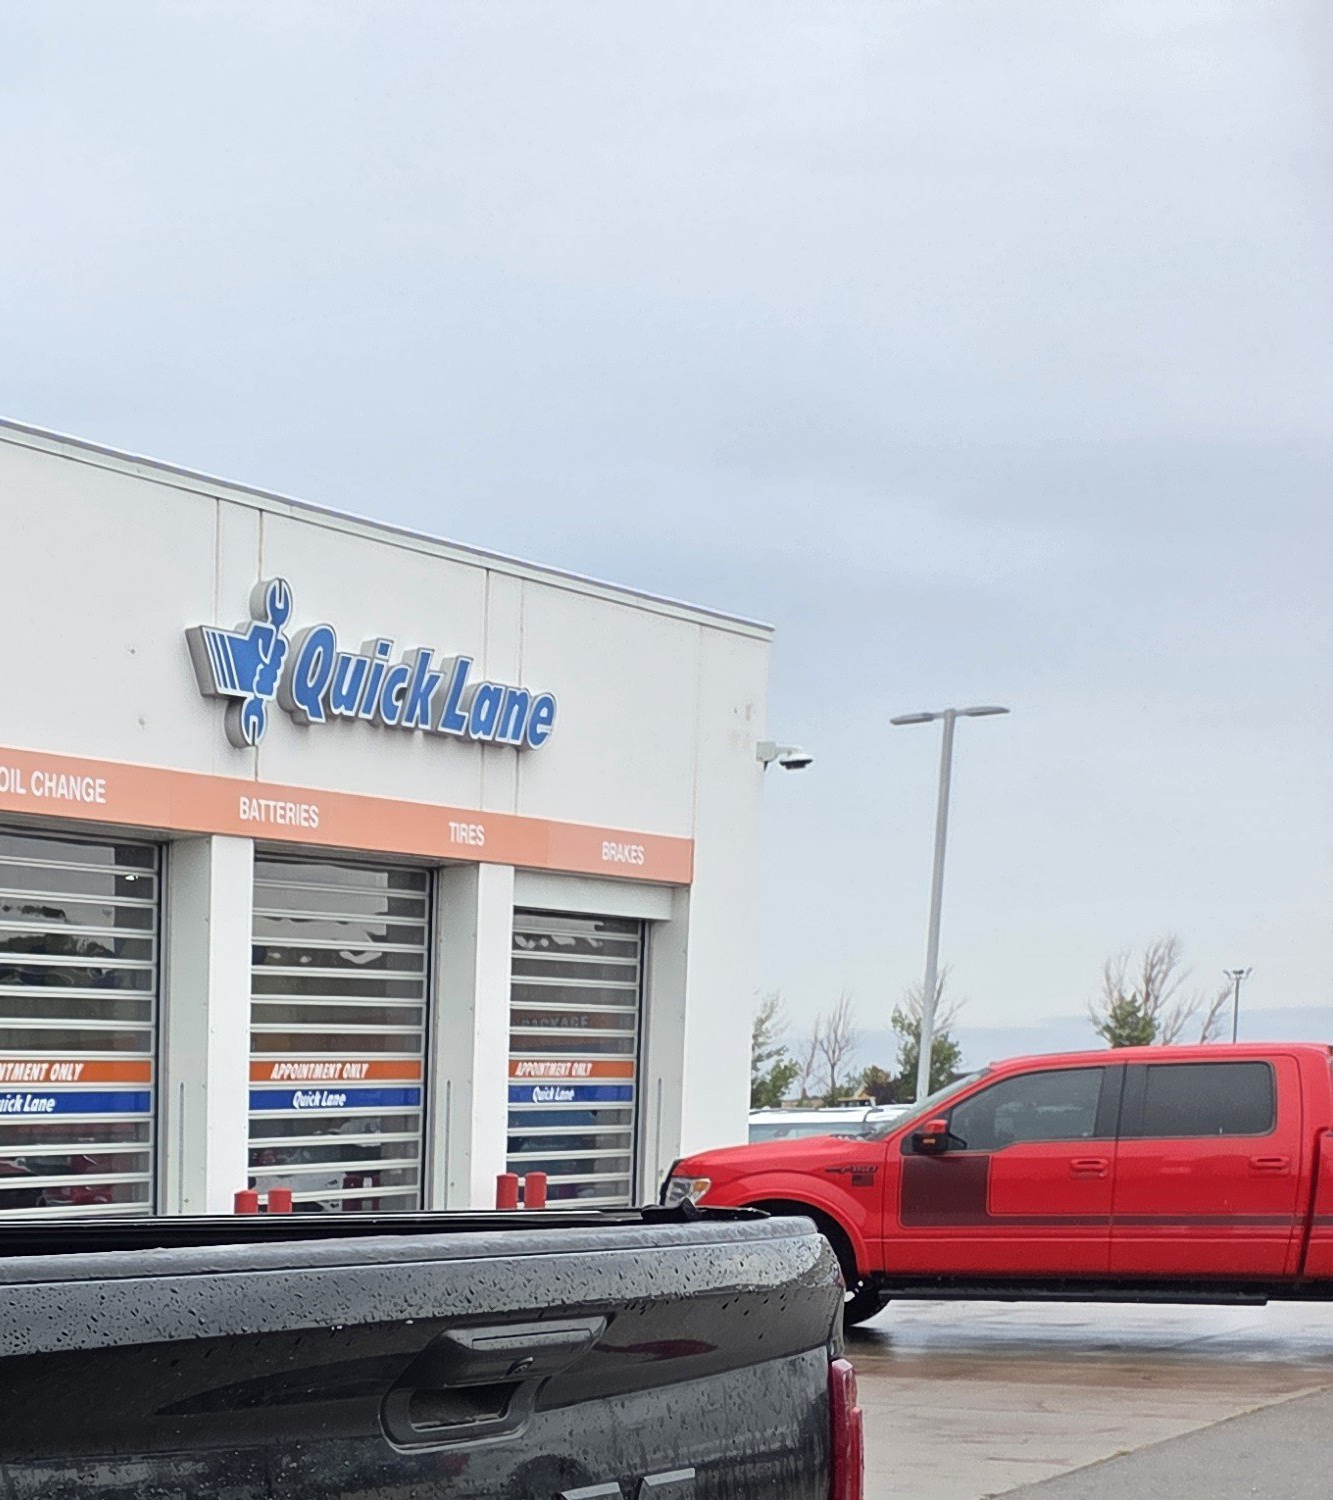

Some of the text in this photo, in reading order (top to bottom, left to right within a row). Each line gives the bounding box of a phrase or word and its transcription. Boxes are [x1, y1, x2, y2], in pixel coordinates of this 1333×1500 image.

[292, 624, 557, 750] Quick Lane
[30, 770, 107, 804] CHANGE
[239, 796, 320, 829] BATTERIES
[448, 821, 485, 846] TIRES
[601, 841, 645, 865] BRAKES
[50, 1063, 84, 1081] ONLY
[270, 1063, 369, 1079] APPOINTMENT ONLY
[23, 1094, 56, 1112] Lane
[293, 1091, 347, 1109] Quick Lane
